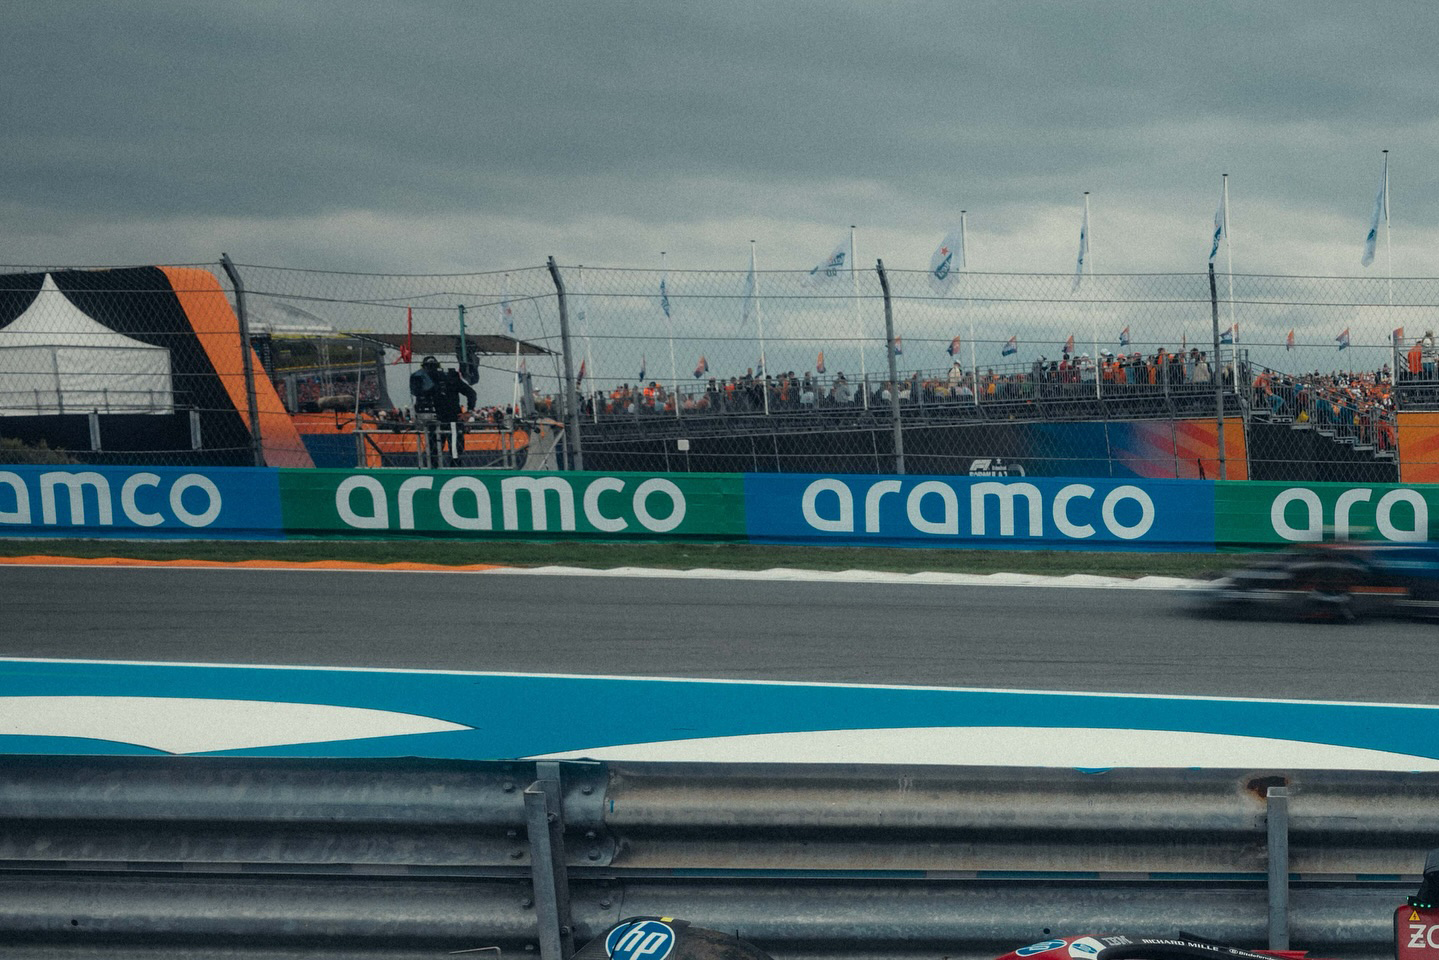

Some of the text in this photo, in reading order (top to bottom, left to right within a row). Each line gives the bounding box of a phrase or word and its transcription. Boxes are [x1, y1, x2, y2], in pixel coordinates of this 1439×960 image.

[336, 475, 686, 532] aramco
[802, 478, 1154, 539] aramco
[1142, 938, 1219, 952] RICHARD MILLE
